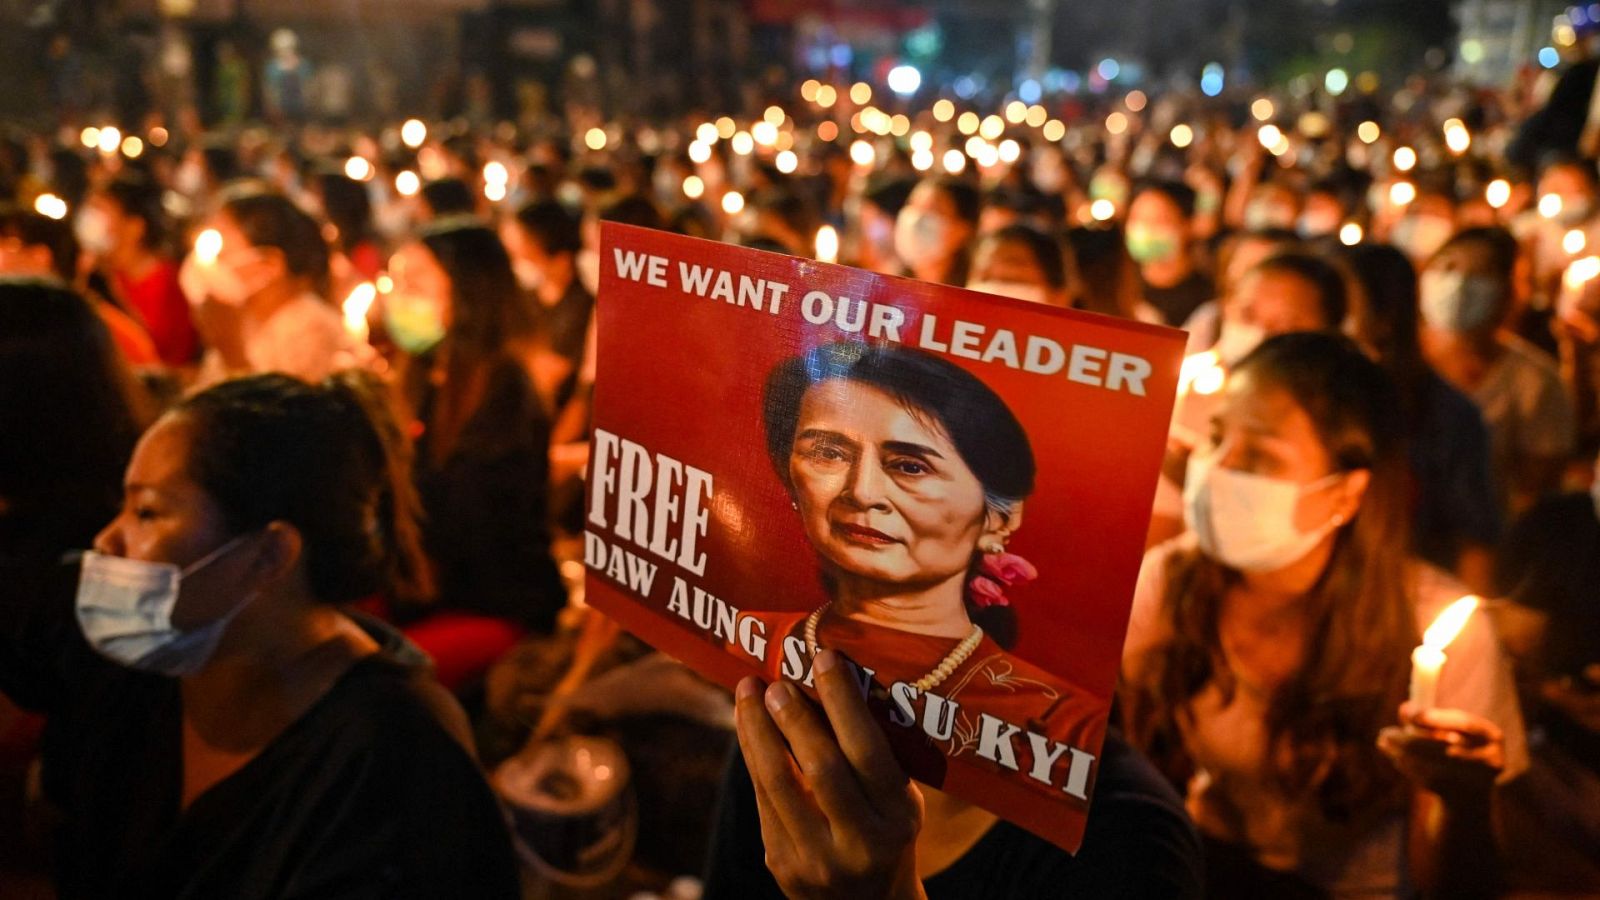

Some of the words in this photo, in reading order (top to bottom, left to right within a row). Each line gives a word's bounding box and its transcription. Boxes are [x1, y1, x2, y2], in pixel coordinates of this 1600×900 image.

[613, 247, 669, 288] WE
[679, 261, 789, 315] WANT
[801, 290, 905, 342] OUR
[919, 314, 1152, 396] LEADER
[588, 428, 713, 577] FREE
[584, 530, 658, 597] DAW
[667, 576, 767, 662] AUNG
[889, 682, 958, 741] SU
[976, 713, 1096, 801] KYI
